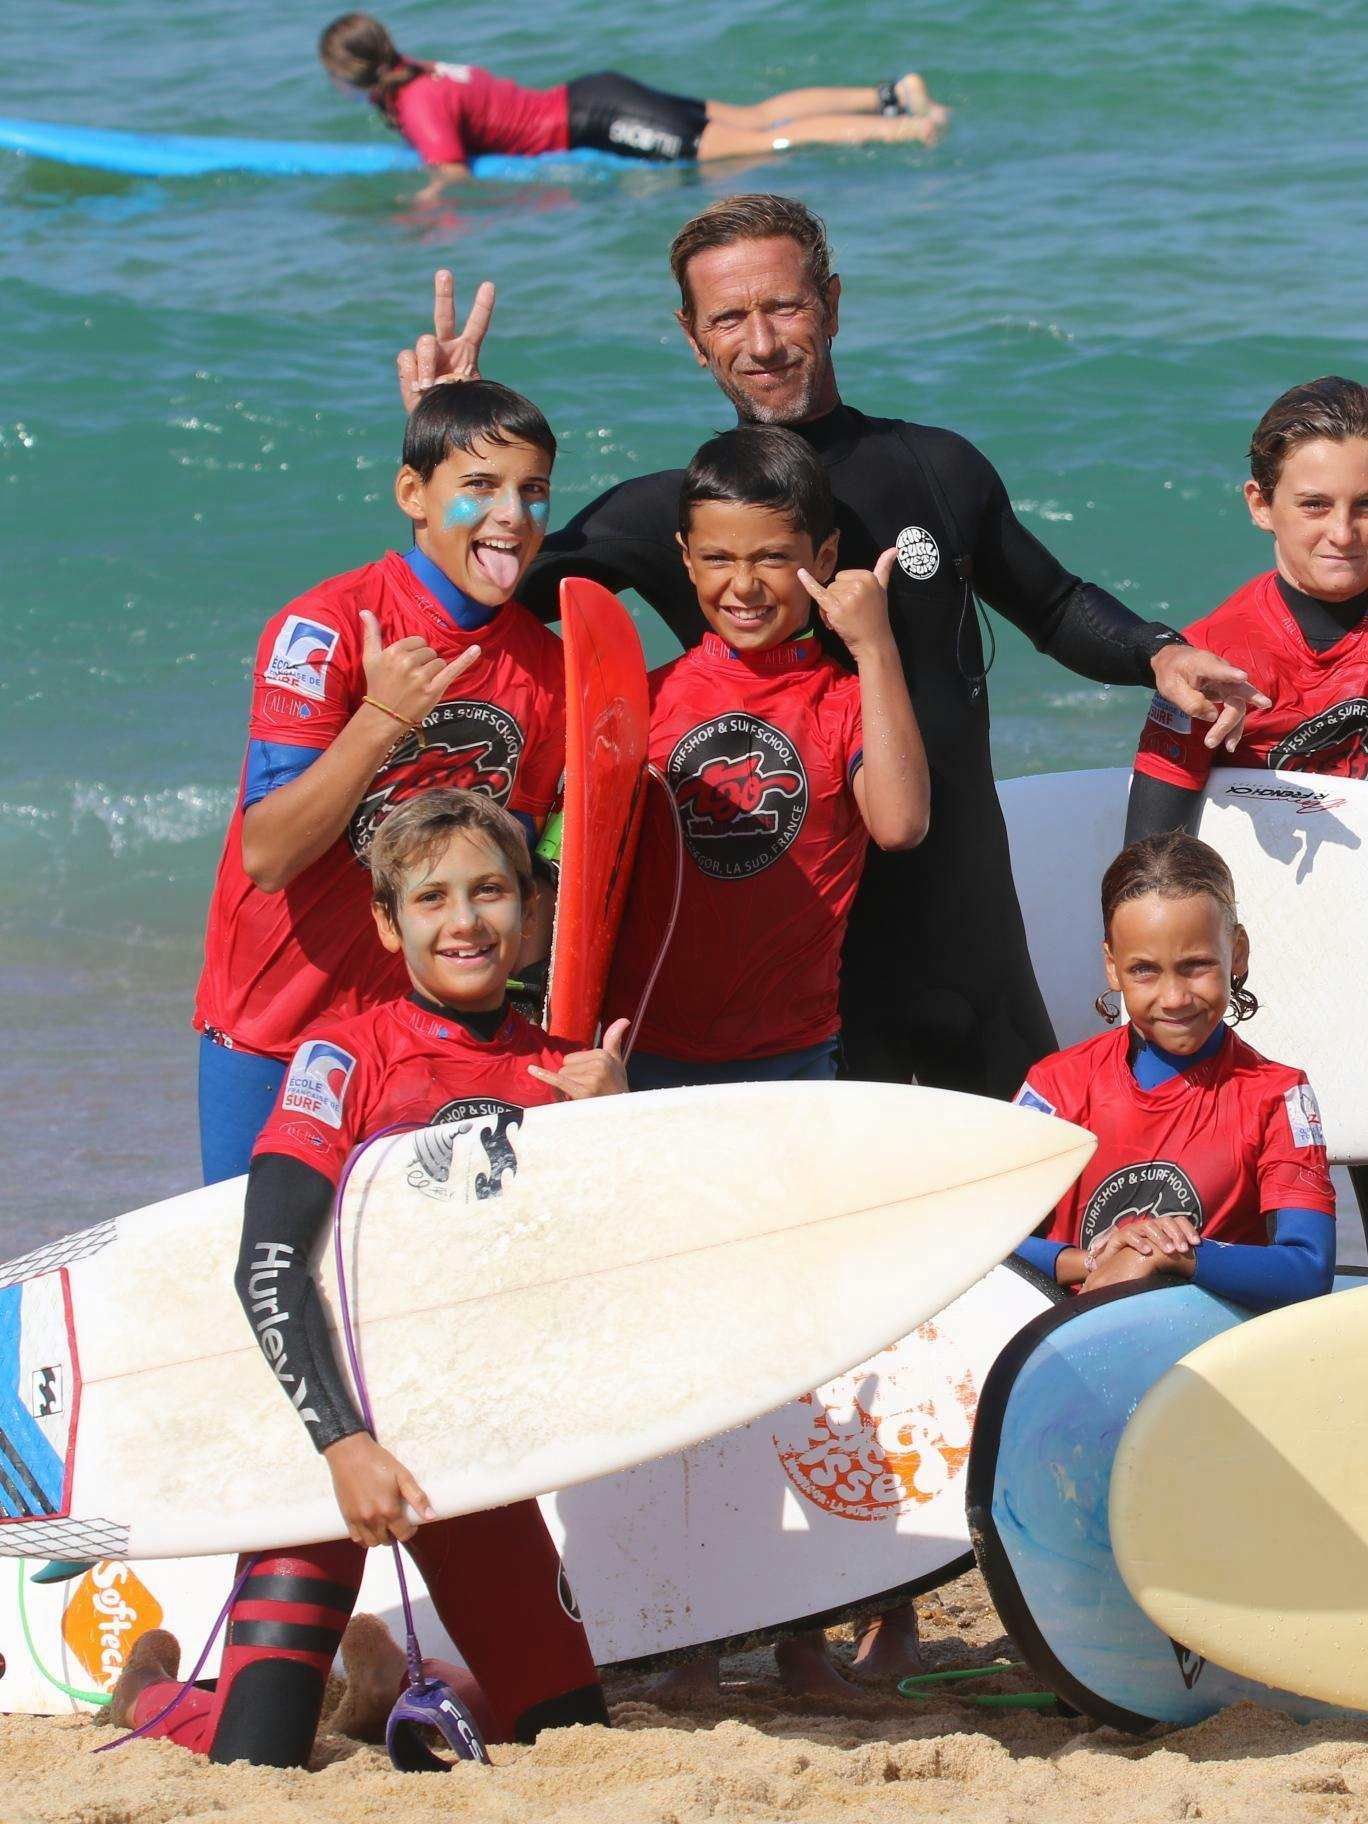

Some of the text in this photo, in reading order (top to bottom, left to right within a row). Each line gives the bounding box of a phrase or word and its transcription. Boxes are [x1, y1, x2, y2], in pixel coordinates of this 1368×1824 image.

[899, 543, 937, 560] CURL
[718, 722, 728, 734] &
[726, 865, 741, 874] LA
[771, 804, 803, 855] FRANCE
[285, 1094, 321, 1112] SURF
[469, 1104, 478, 1115] &
[1086, 1177, 1125, 1236] SURFSHOP
[1128, 1173, 1139, 1184] &
[249, 1242, 296, 1382] Hurley
[92, 1560, 137, 1691] Softech
[440, 1699, 484, 1761] FCS
